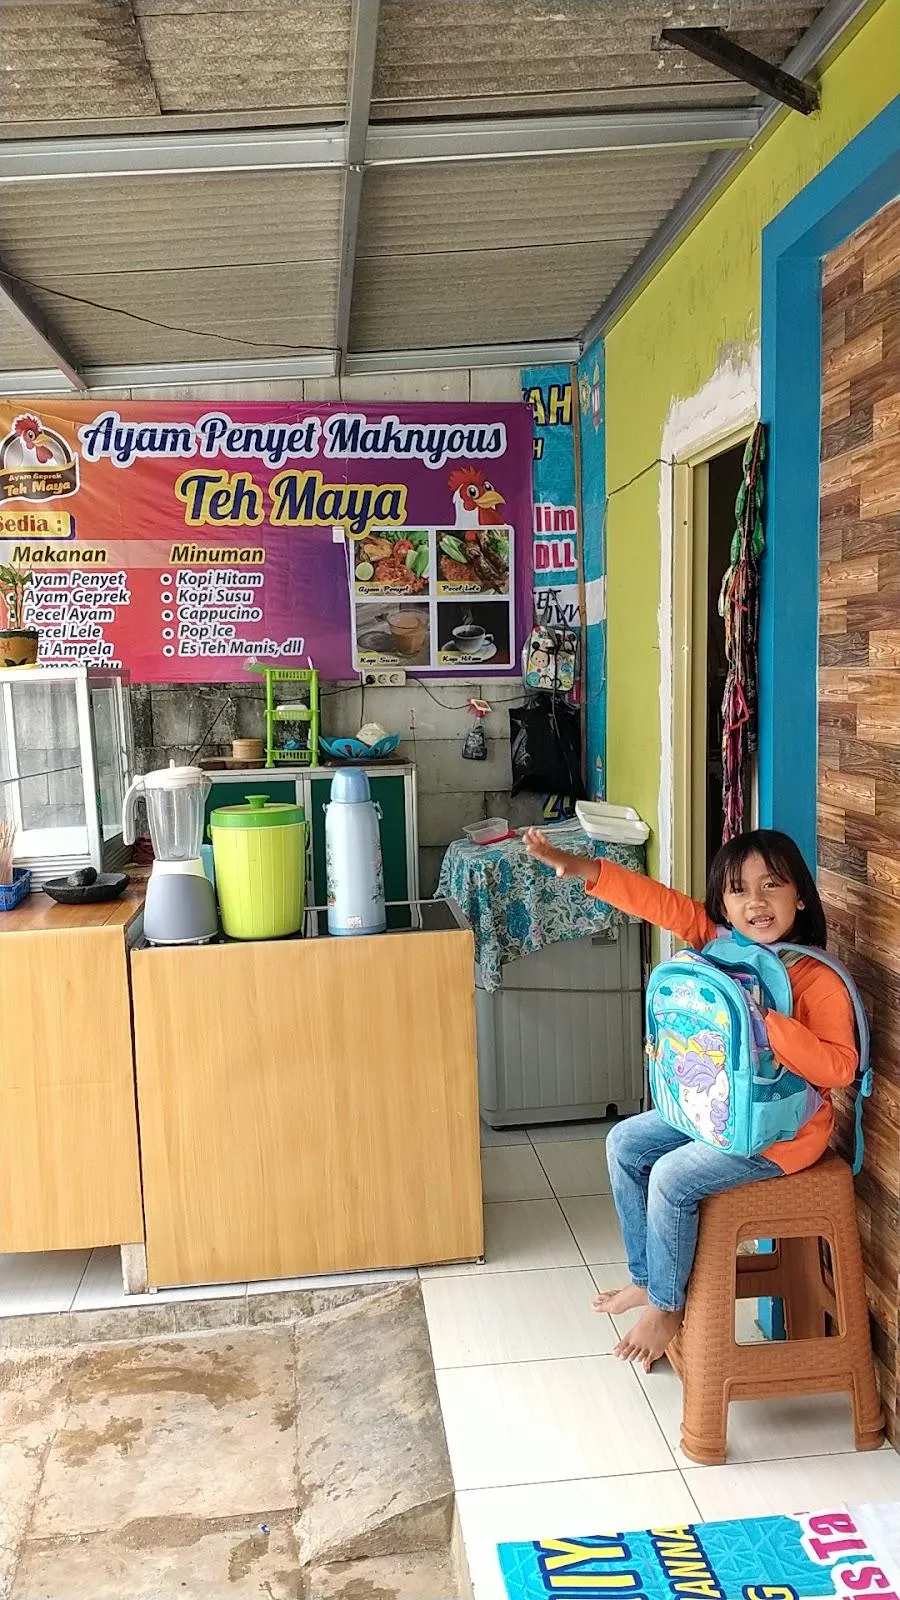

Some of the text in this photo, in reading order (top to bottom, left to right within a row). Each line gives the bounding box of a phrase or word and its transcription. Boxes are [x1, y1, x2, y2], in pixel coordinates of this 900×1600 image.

[522, 384, 572, 425] AH
[84, 416, 503, 464] Ayam Penyet Maknyous
[8, 472, 62, 482] Ayam Geprek
[3, 479, 71, 496] Teh Maya
[180, 474, 402, 534] Teh Maya
[12, 545, 107, 562] Makanan
[171, 545, 264, 562] Minuman
[535, 542, 576, 570] DLL
[71, 572, 125, 589] Penyet
[178, 572, 262, 588] Kopi Hitam
[25, 589, 129, 607] Ayam Geprek
[179, 589, 252, 605] Kopi Susu
[26, 608, 113, 623] Pecel Ayam
[179, 606, 261, 623] Cappucino
[70, 625, 101, 638] Lele
[180, 624, 233, 639] Pop Ice
[52, 641, 112, 658] Ampela
[181, 639, 303, 656] Es Teh Manis, dll
[793, 1511, 868, 1560] Ta
[648, 1525, 726, 1600] ANNA
